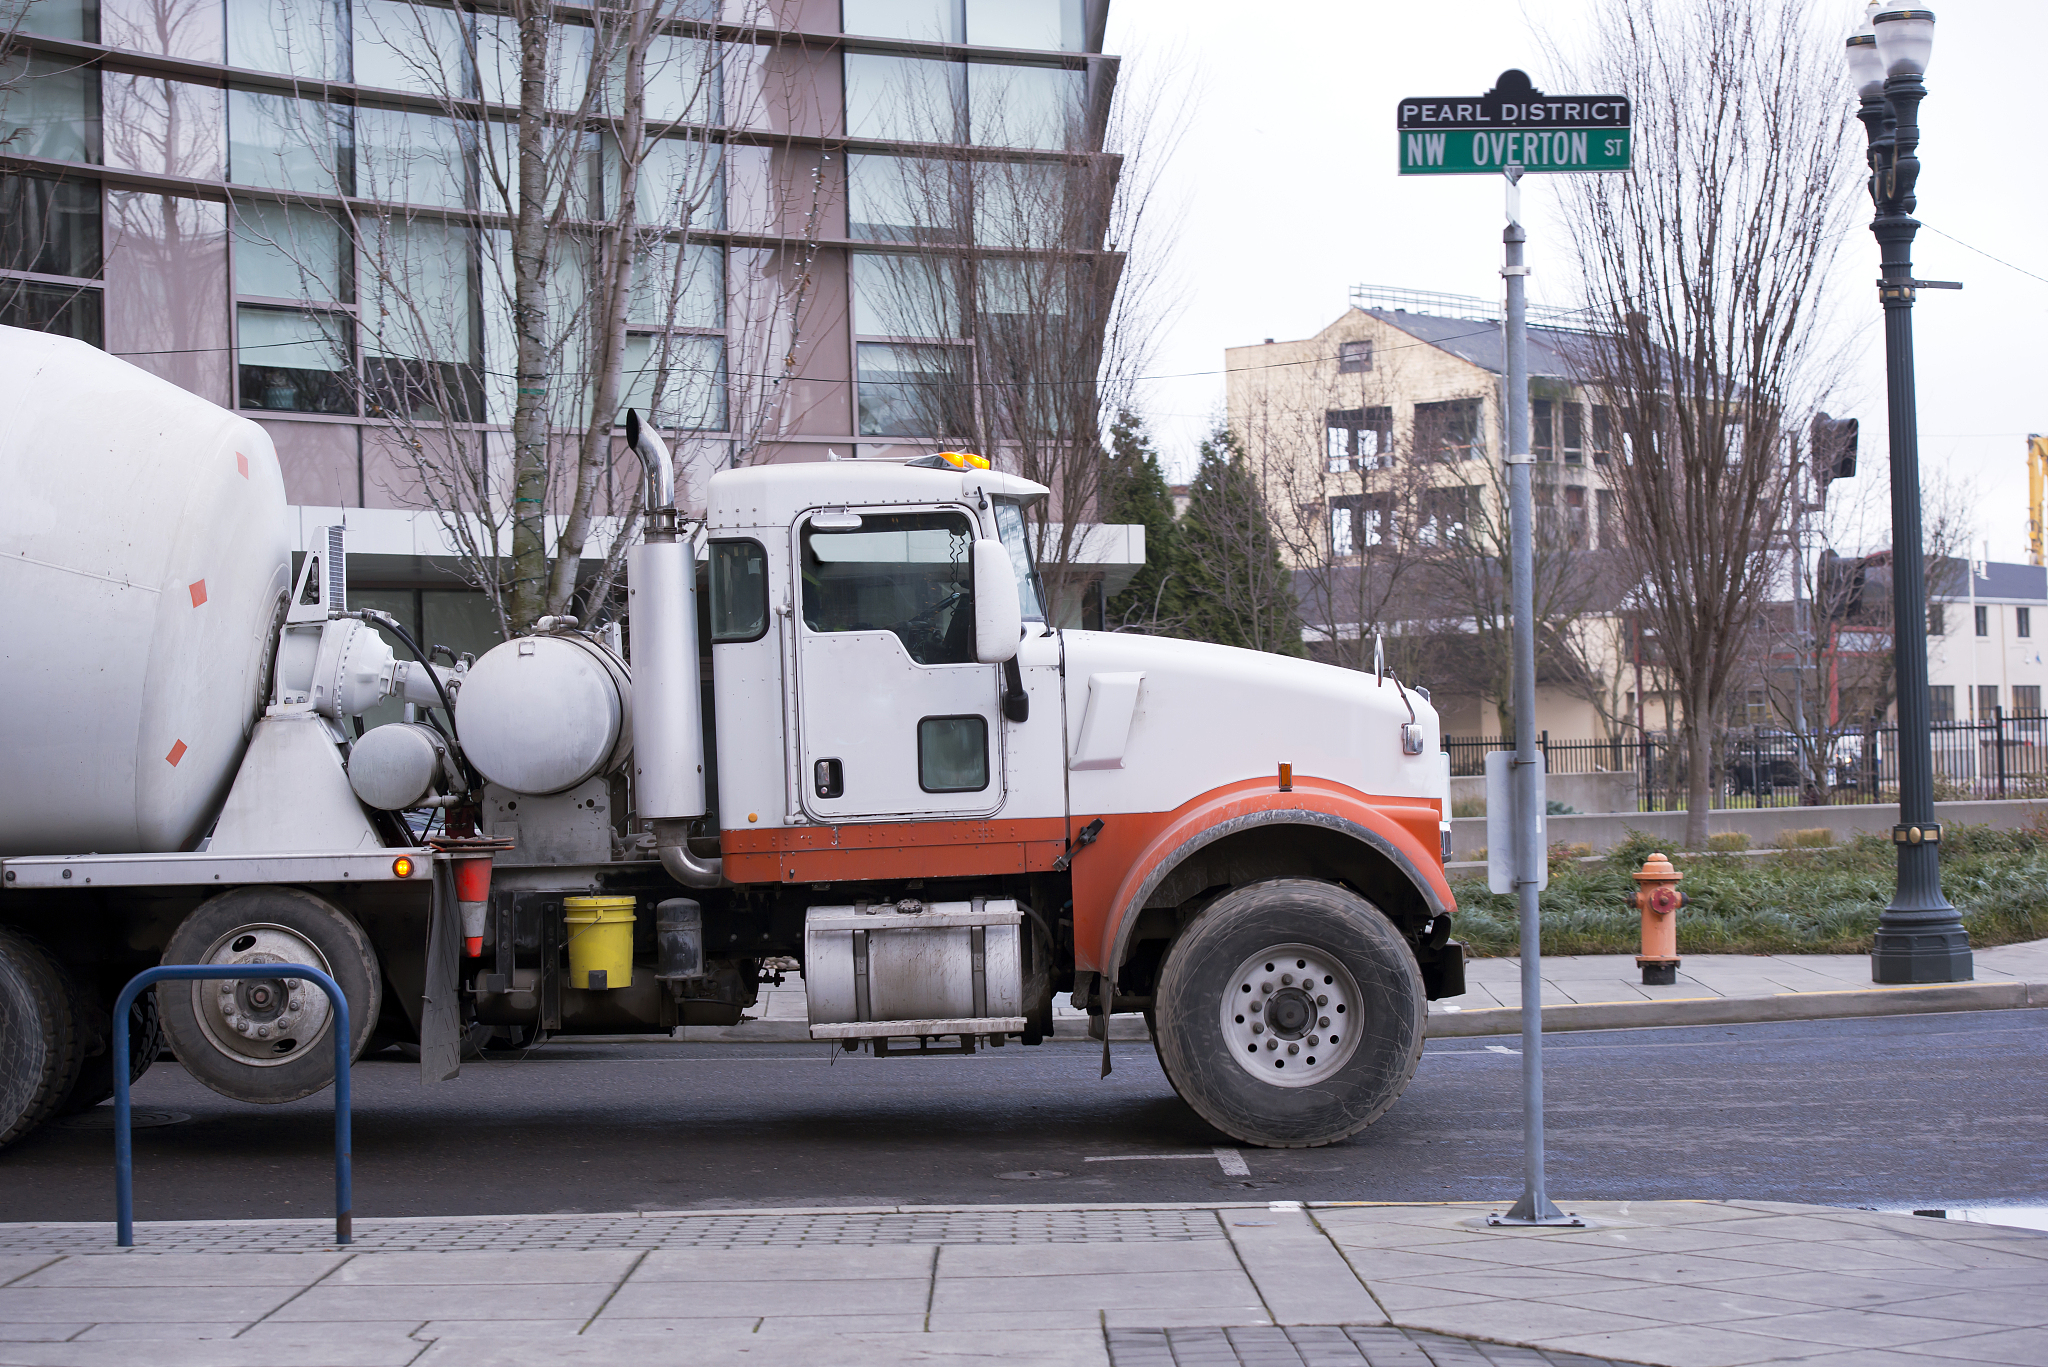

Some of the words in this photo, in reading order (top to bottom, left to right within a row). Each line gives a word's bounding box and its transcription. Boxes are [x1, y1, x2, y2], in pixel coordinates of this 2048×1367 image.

[1402, 104, 1491, 122] PEARL
[1501, 102, 1625, 121] DISTRICT
[1407, 133, 1446, 166] NW
[1472, 131, 1588, 166] OVERTON
[1604, 139, 1623, 156] ST
